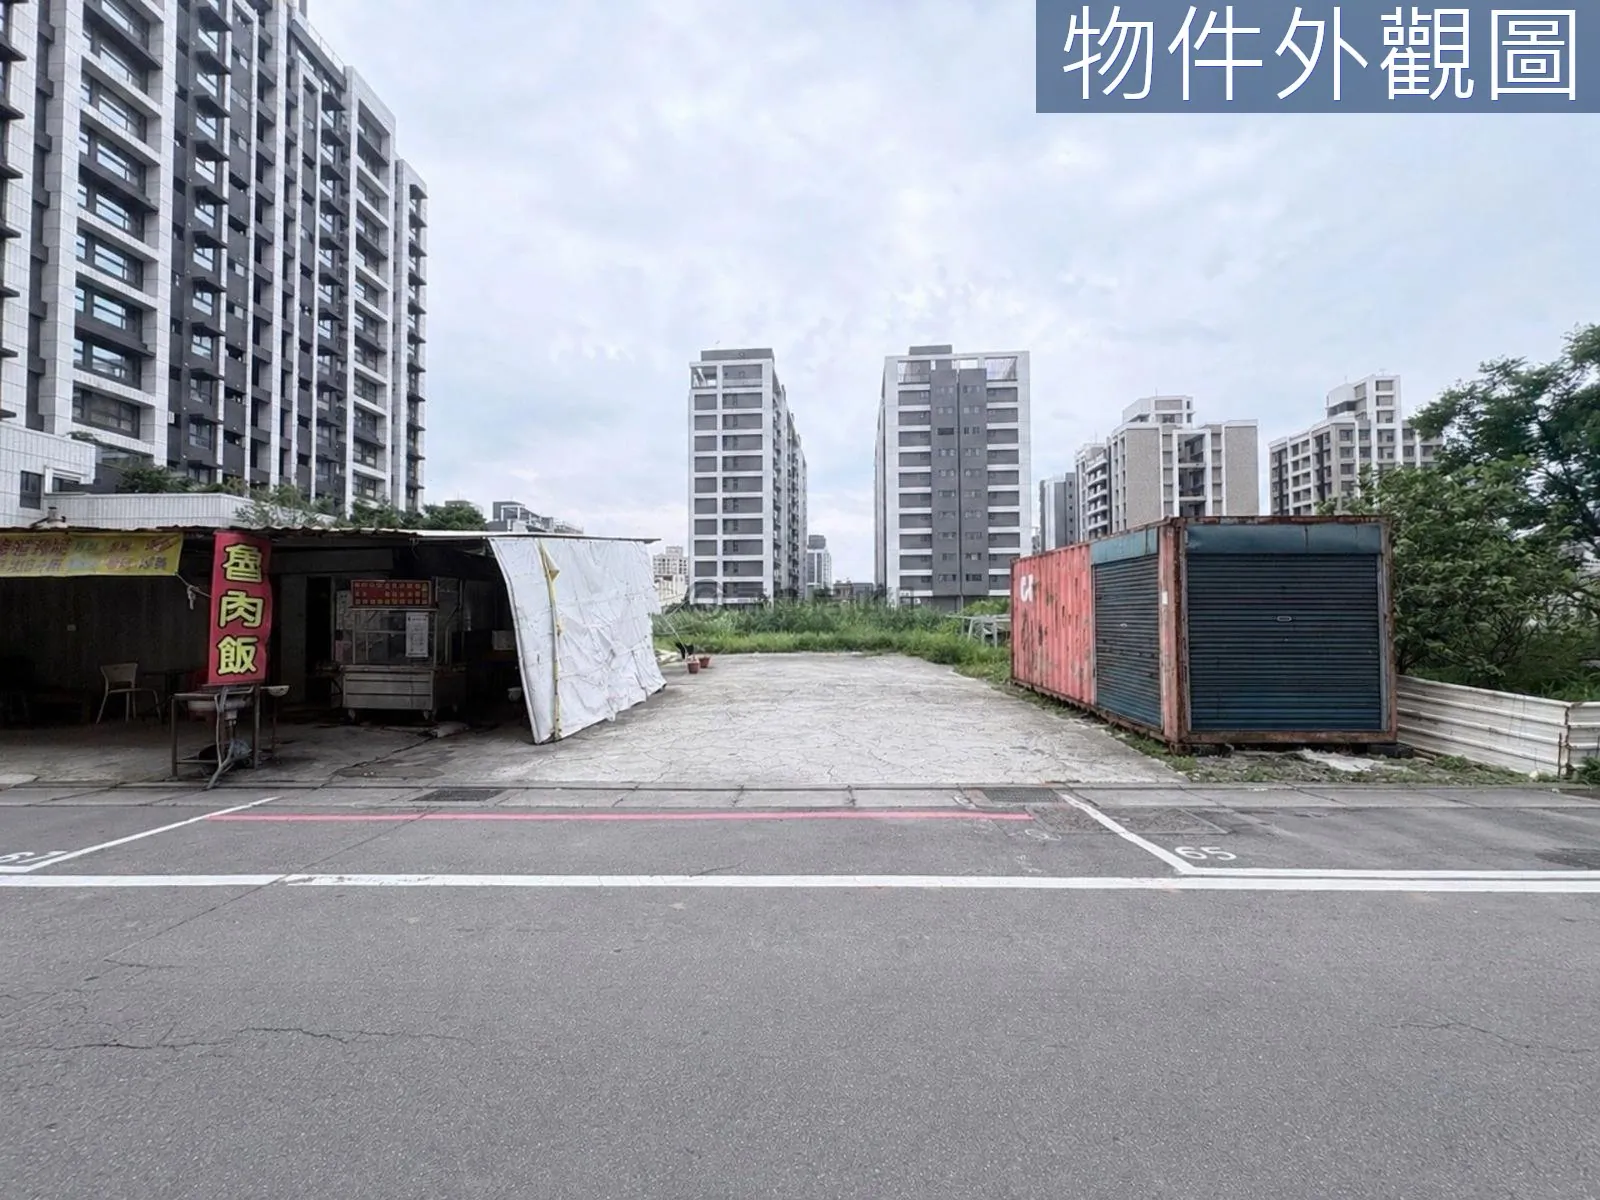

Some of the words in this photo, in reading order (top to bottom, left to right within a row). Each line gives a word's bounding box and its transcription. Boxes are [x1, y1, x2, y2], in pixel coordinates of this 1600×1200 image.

[217, 543, 264, 675] 魯肉飯
[1174, 846, 1236, 861] 65
